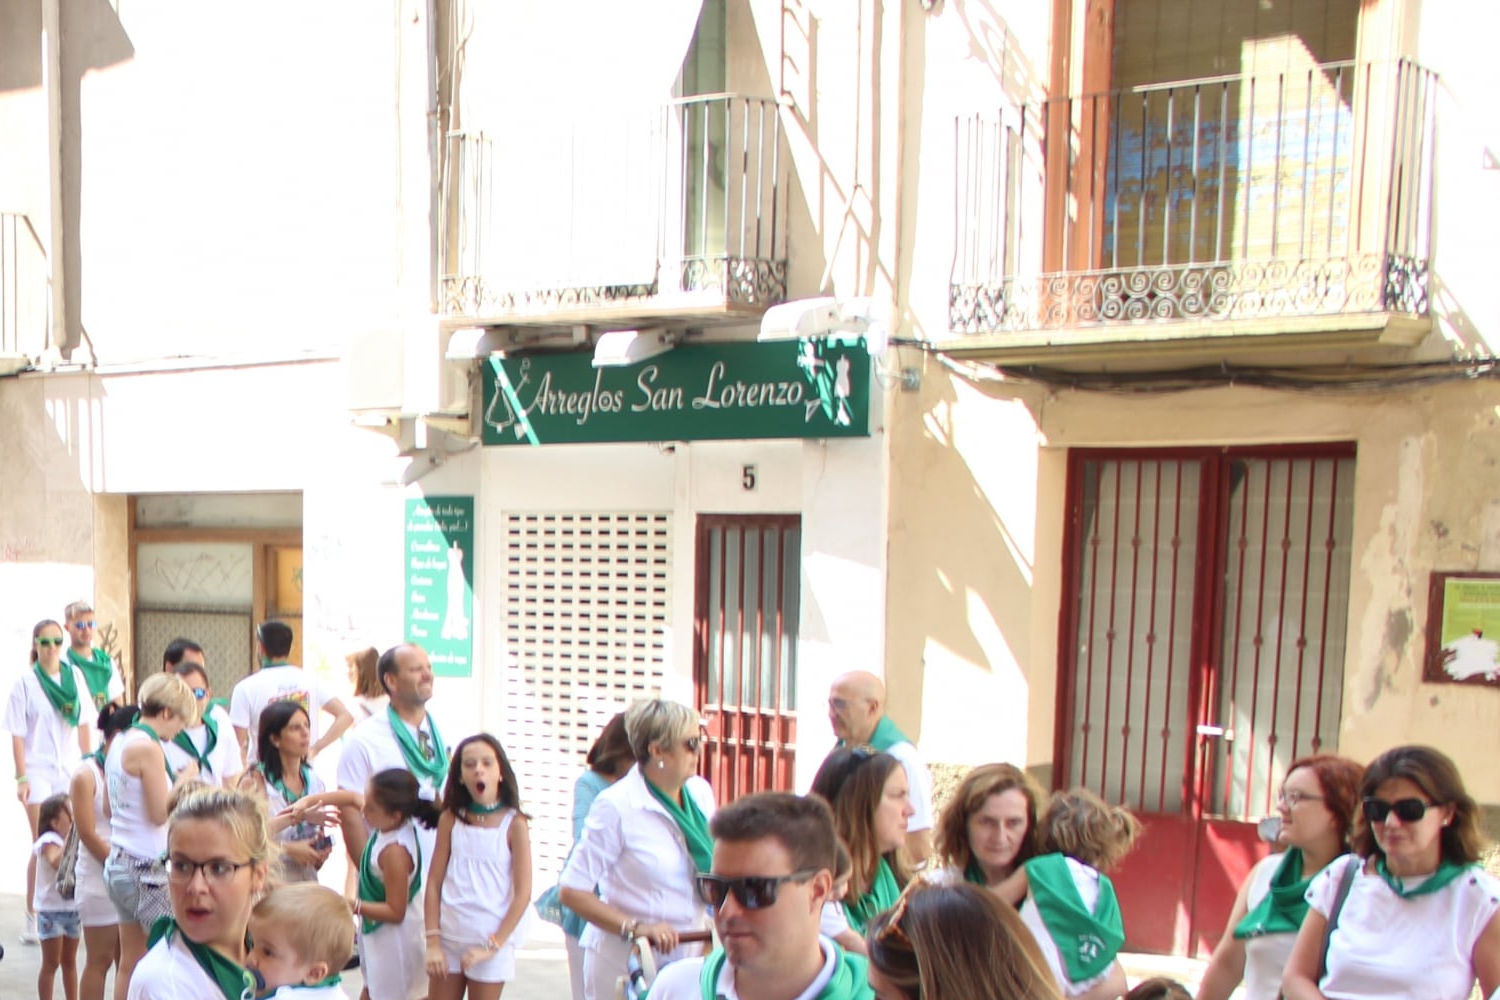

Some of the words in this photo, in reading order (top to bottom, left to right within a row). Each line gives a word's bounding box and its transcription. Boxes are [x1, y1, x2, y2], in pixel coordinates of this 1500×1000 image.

[526, 366, 624, 426] Arreglos
[631, 365, 684, 412] San
[692, 361, 803, 410] Lorenzo
[742, 465, 756, 491] 5
